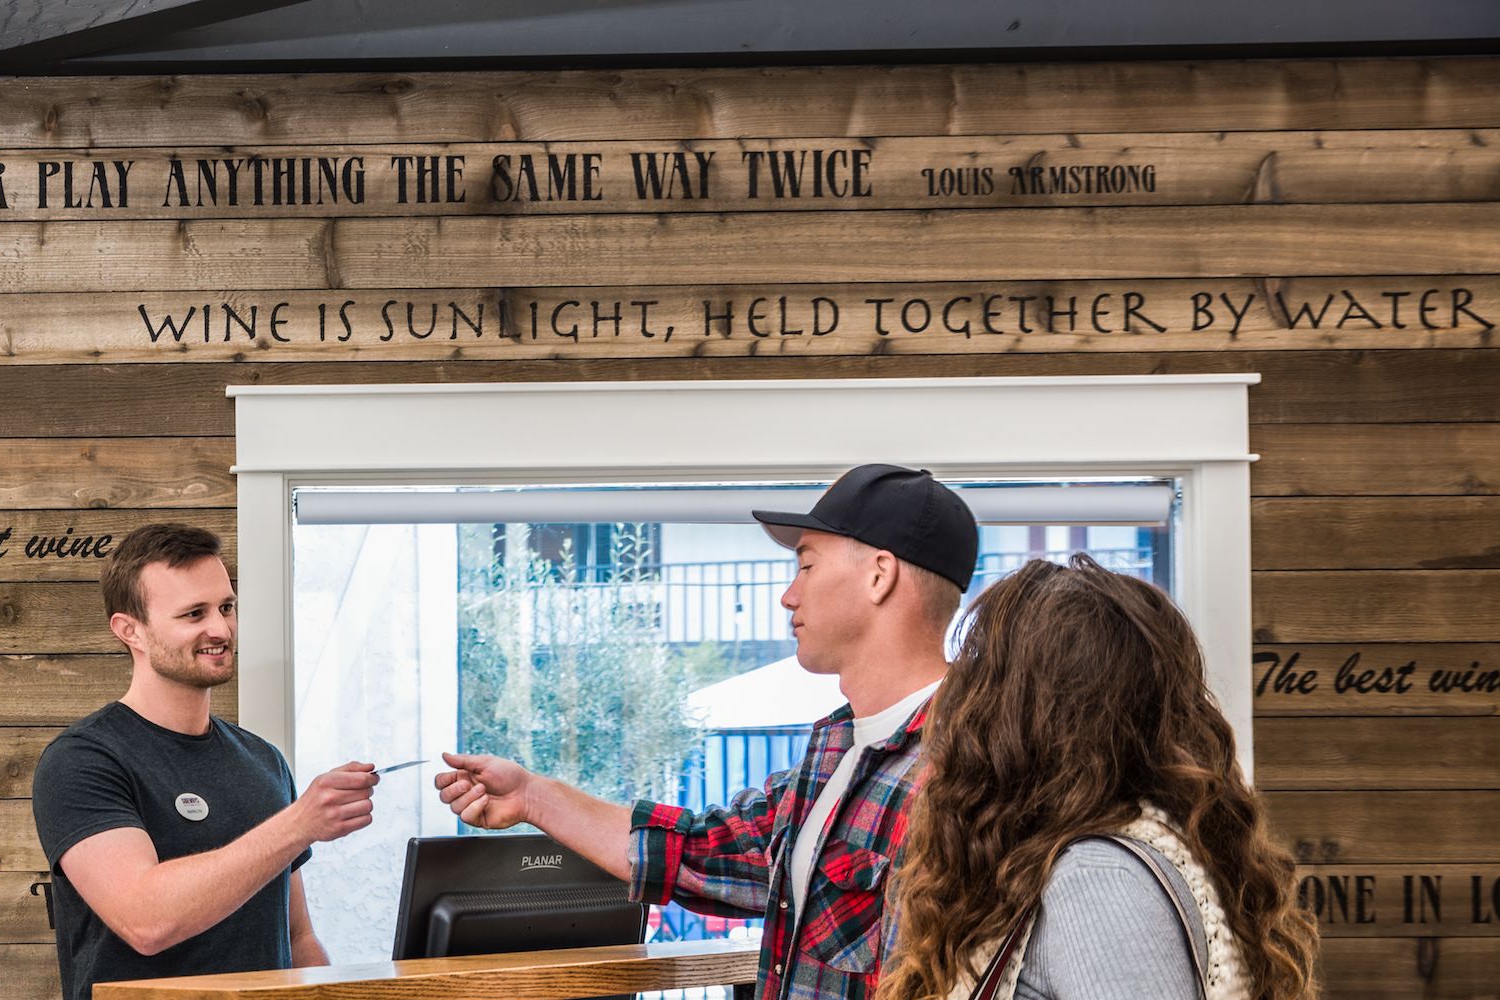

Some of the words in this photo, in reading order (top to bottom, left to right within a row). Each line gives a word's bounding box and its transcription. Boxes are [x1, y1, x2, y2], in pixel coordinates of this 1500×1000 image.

[37, 160, 134, 209] PLAY
[162, 156, 366, 207] ANYTHING
[391, 155, 466, 204] THE
[492, 152, 602, 202] SAME
[630, 151, 717, 200] WAY
[742, 149, 872, 199] TWICE
[921, 167, 994, 196] LOUIS
[1008, 165, 1156, 195] ARMSTRONG
[138, 302, 291, 343] WINE
[318, 300, 355, 342] IS
[380, 299, 674, 344] SUNLIGHT,
[702, 296, 840, 338] HELD
[865, 294, 1167, 339] TOGETHER
[1191, 291, 1254, 339] BY
[1274, 288, 1497, 332] WATER
[25, 527, 113, 559] wine
[1252, 651, 1319, 697] The
[1333, 651, 1417, 695] best
[521, 854, 563, 867] PLANAR
[1402, 874, 1444, 924] IN
